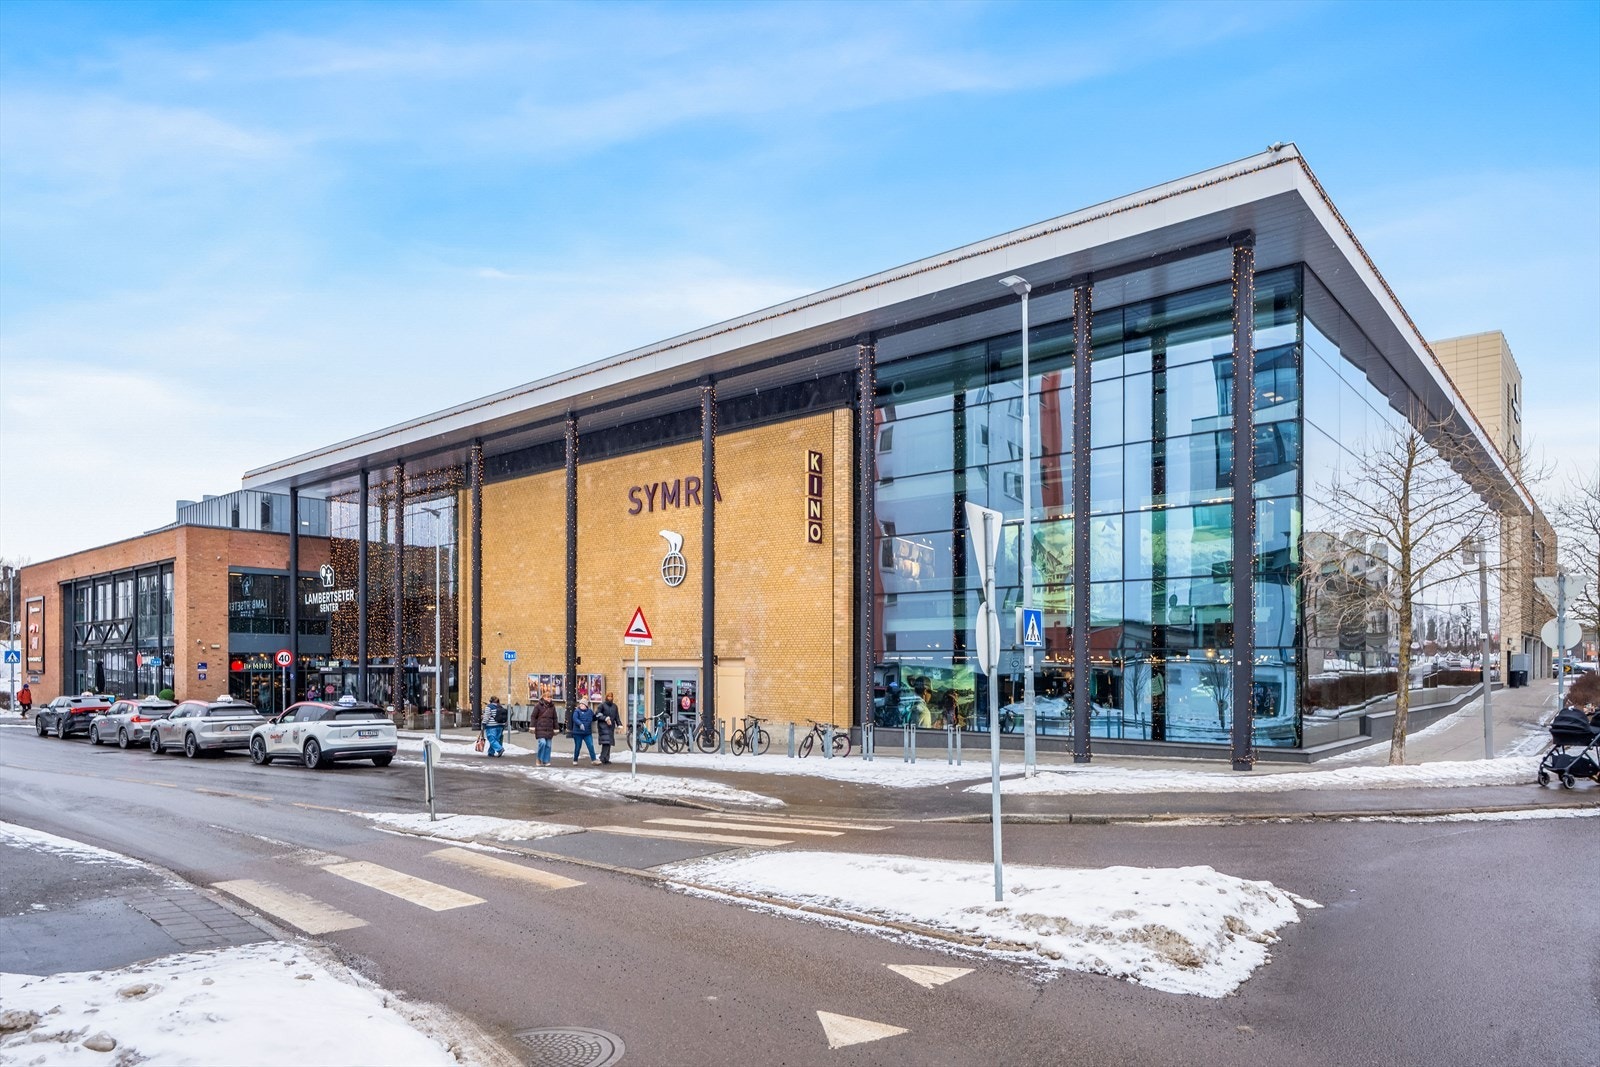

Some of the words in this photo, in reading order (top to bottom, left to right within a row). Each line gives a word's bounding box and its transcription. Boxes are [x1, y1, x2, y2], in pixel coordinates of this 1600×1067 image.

[810, 453, 822, 542] KINO
[304, 589, 355, 605] LAMBERTSETER
[319, 603, 339, 613] SENTER
[278, 654, 290, 663] 40
